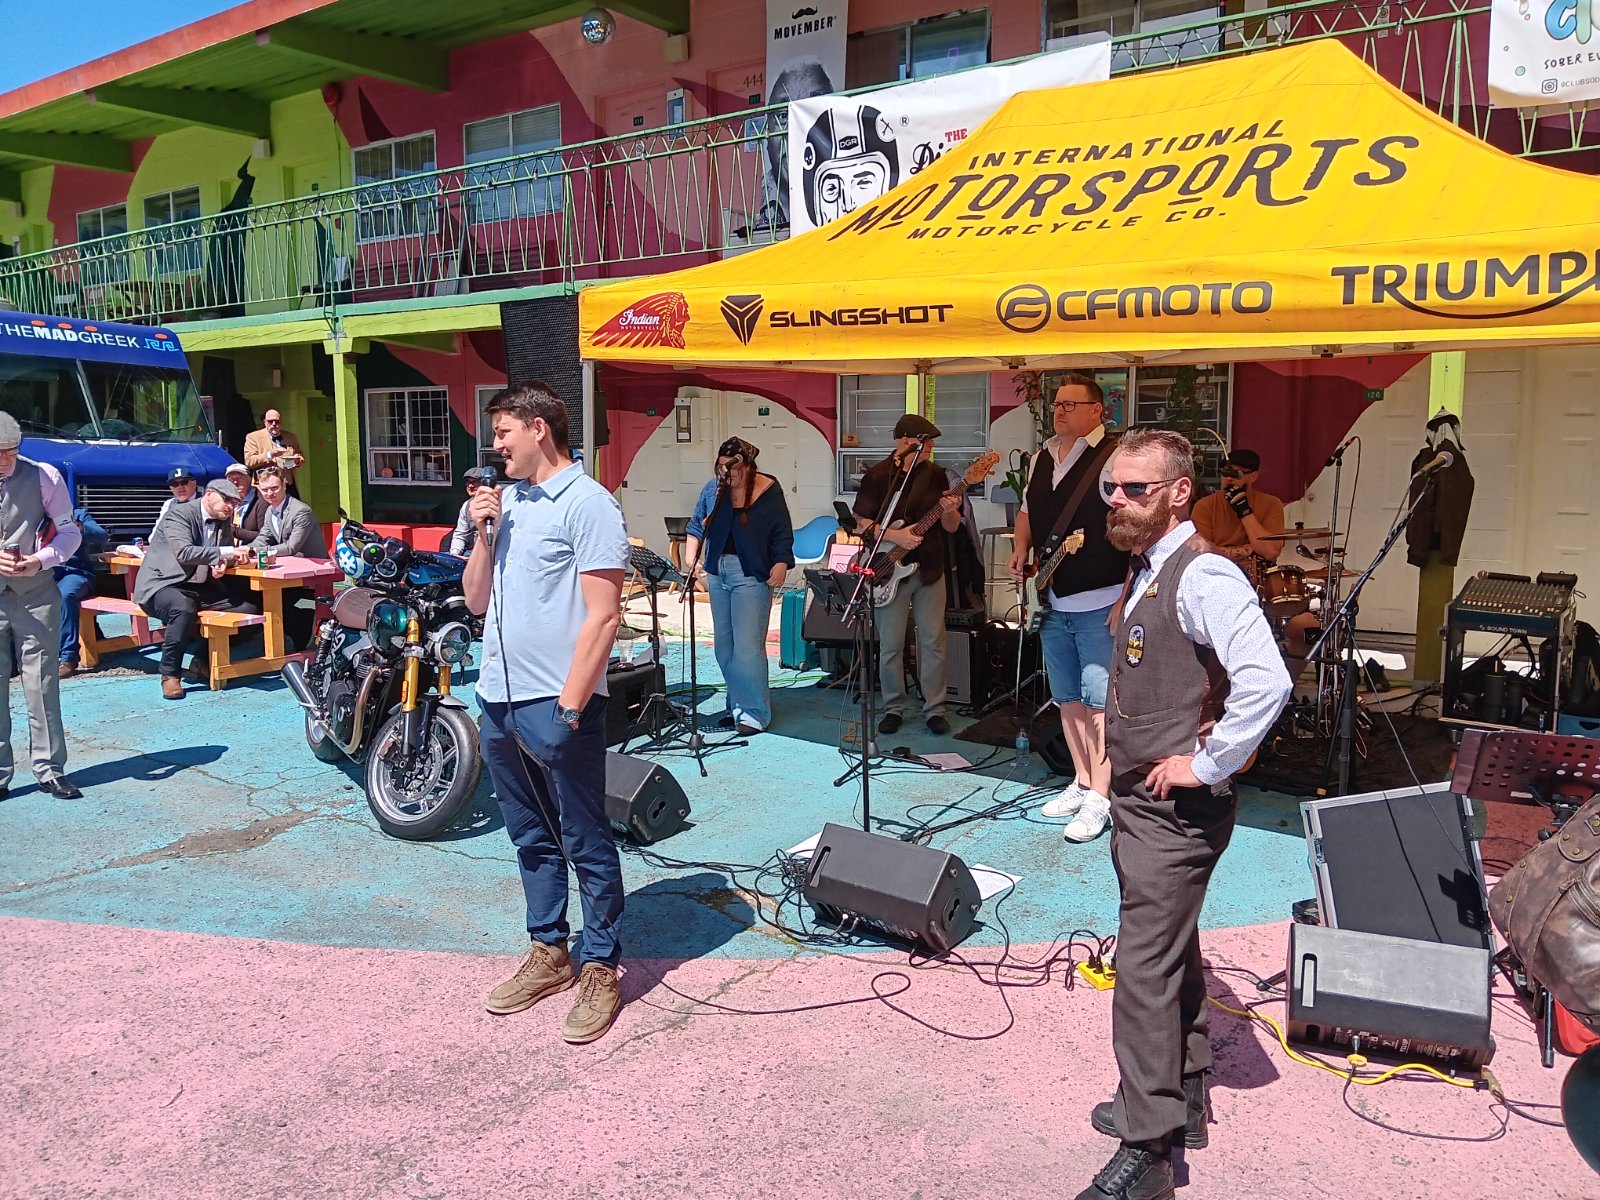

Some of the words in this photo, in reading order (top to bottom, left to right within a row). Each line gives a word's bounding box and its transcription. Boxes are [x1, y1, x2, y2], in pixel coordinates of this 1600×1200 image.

[774, 16, 834, 40] MOVEMBER
[1544, 53, 1583, 70] SOBER
[743, 73, 763, 88] 444
[1560, 76, 1600, 88] @CLUBSOD
[839, 137, 858, 149] DGR
[944, 128, 968, 142] THE
[968, 119, 1284, 170] INTERNATIONAL
[826, 135, 1420, 242] MOTORSPORTS
[906, 215, 1143, 240] MOTORCYCLE
[1165, 206, 1226, 223] CO.
[1057, 280, 1273, 321] CFMOTO
[619, 309, 660, 326] Indian
[769, 304, 954, 328] SLINGSHOT
[1367, 391, 1381, 399] 126
[174, 468, 182, 478] J
